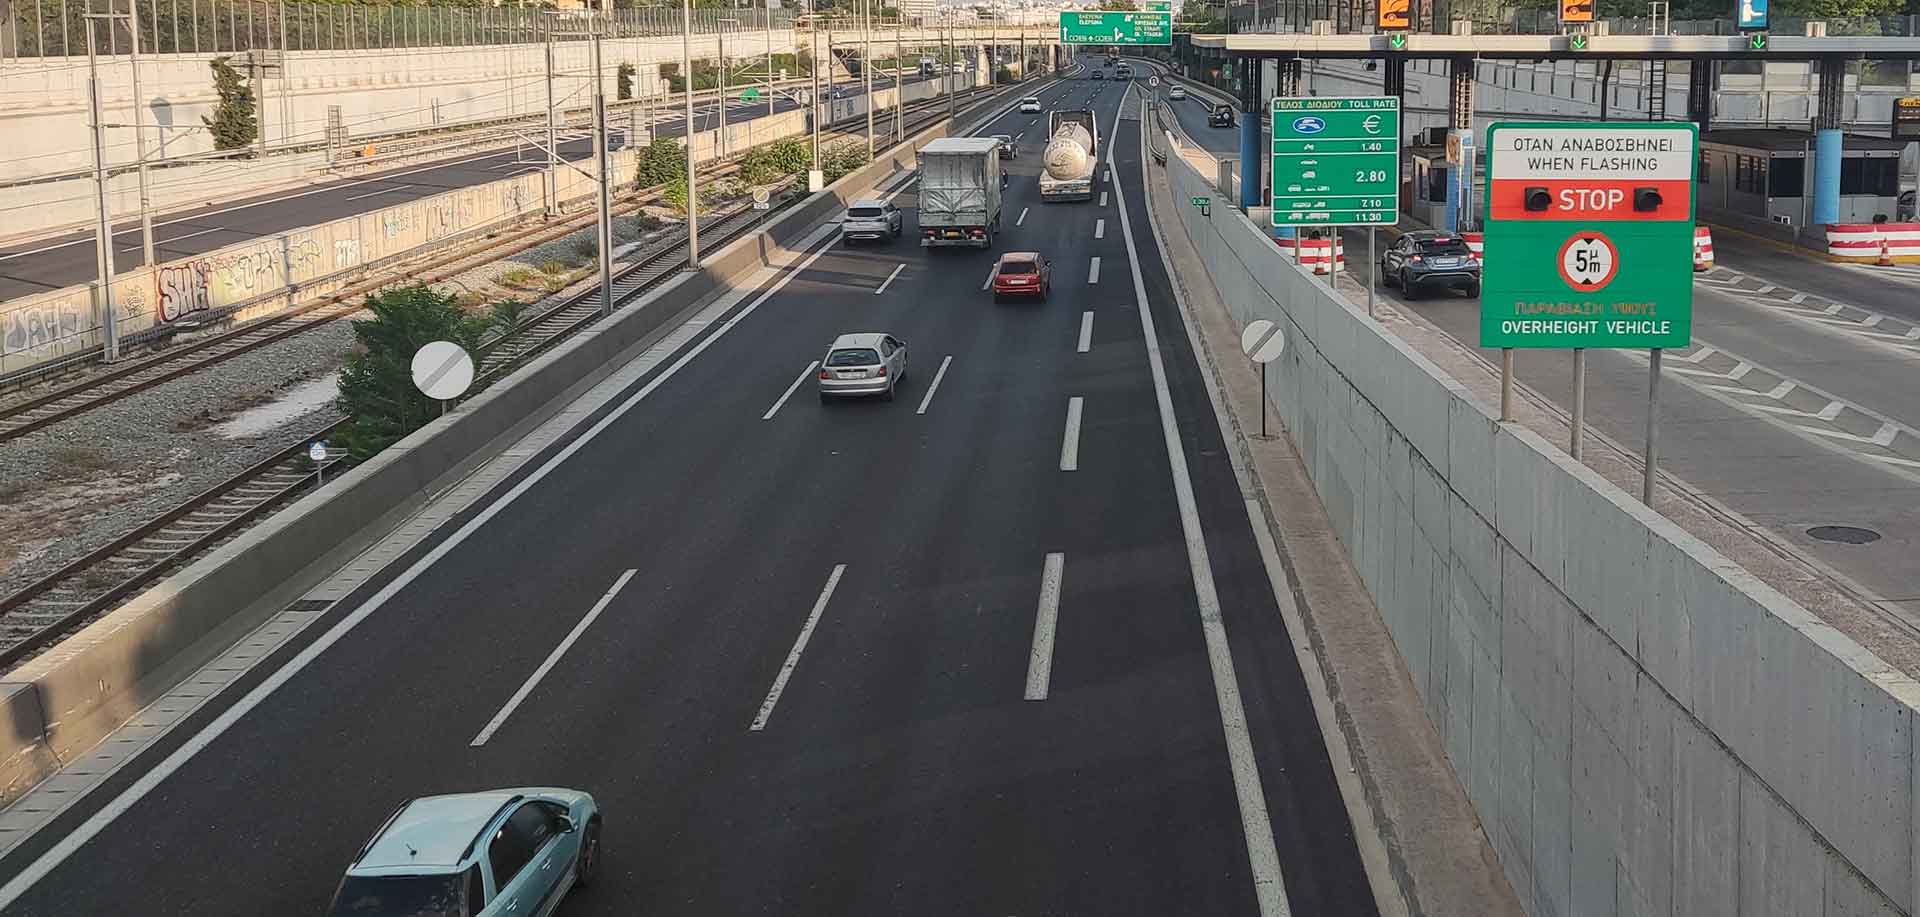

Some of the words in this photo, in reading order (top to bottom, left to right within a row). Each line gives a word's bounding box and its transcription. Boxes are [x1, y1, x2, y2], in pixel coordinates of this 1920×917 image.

[1373, 100, 1396, 108] RATE
[1513, 138, 1553, 152] ΟΤΑΝ
[1561, 138, 1673, 152] ΑΝΑΒΟΣΒΗΝΕΙ
[1527, 158, 1574, 171] WHEN
[1580, 158, 1659, 171] FLASHING
[1356, 170, 1386, 183] 2.80
[1558, 188, 1625, 211] STOP
[1501, 320, 1599, 334] OVERHEIGHT
[1606, 320, 1671, 334] VEHICLE
